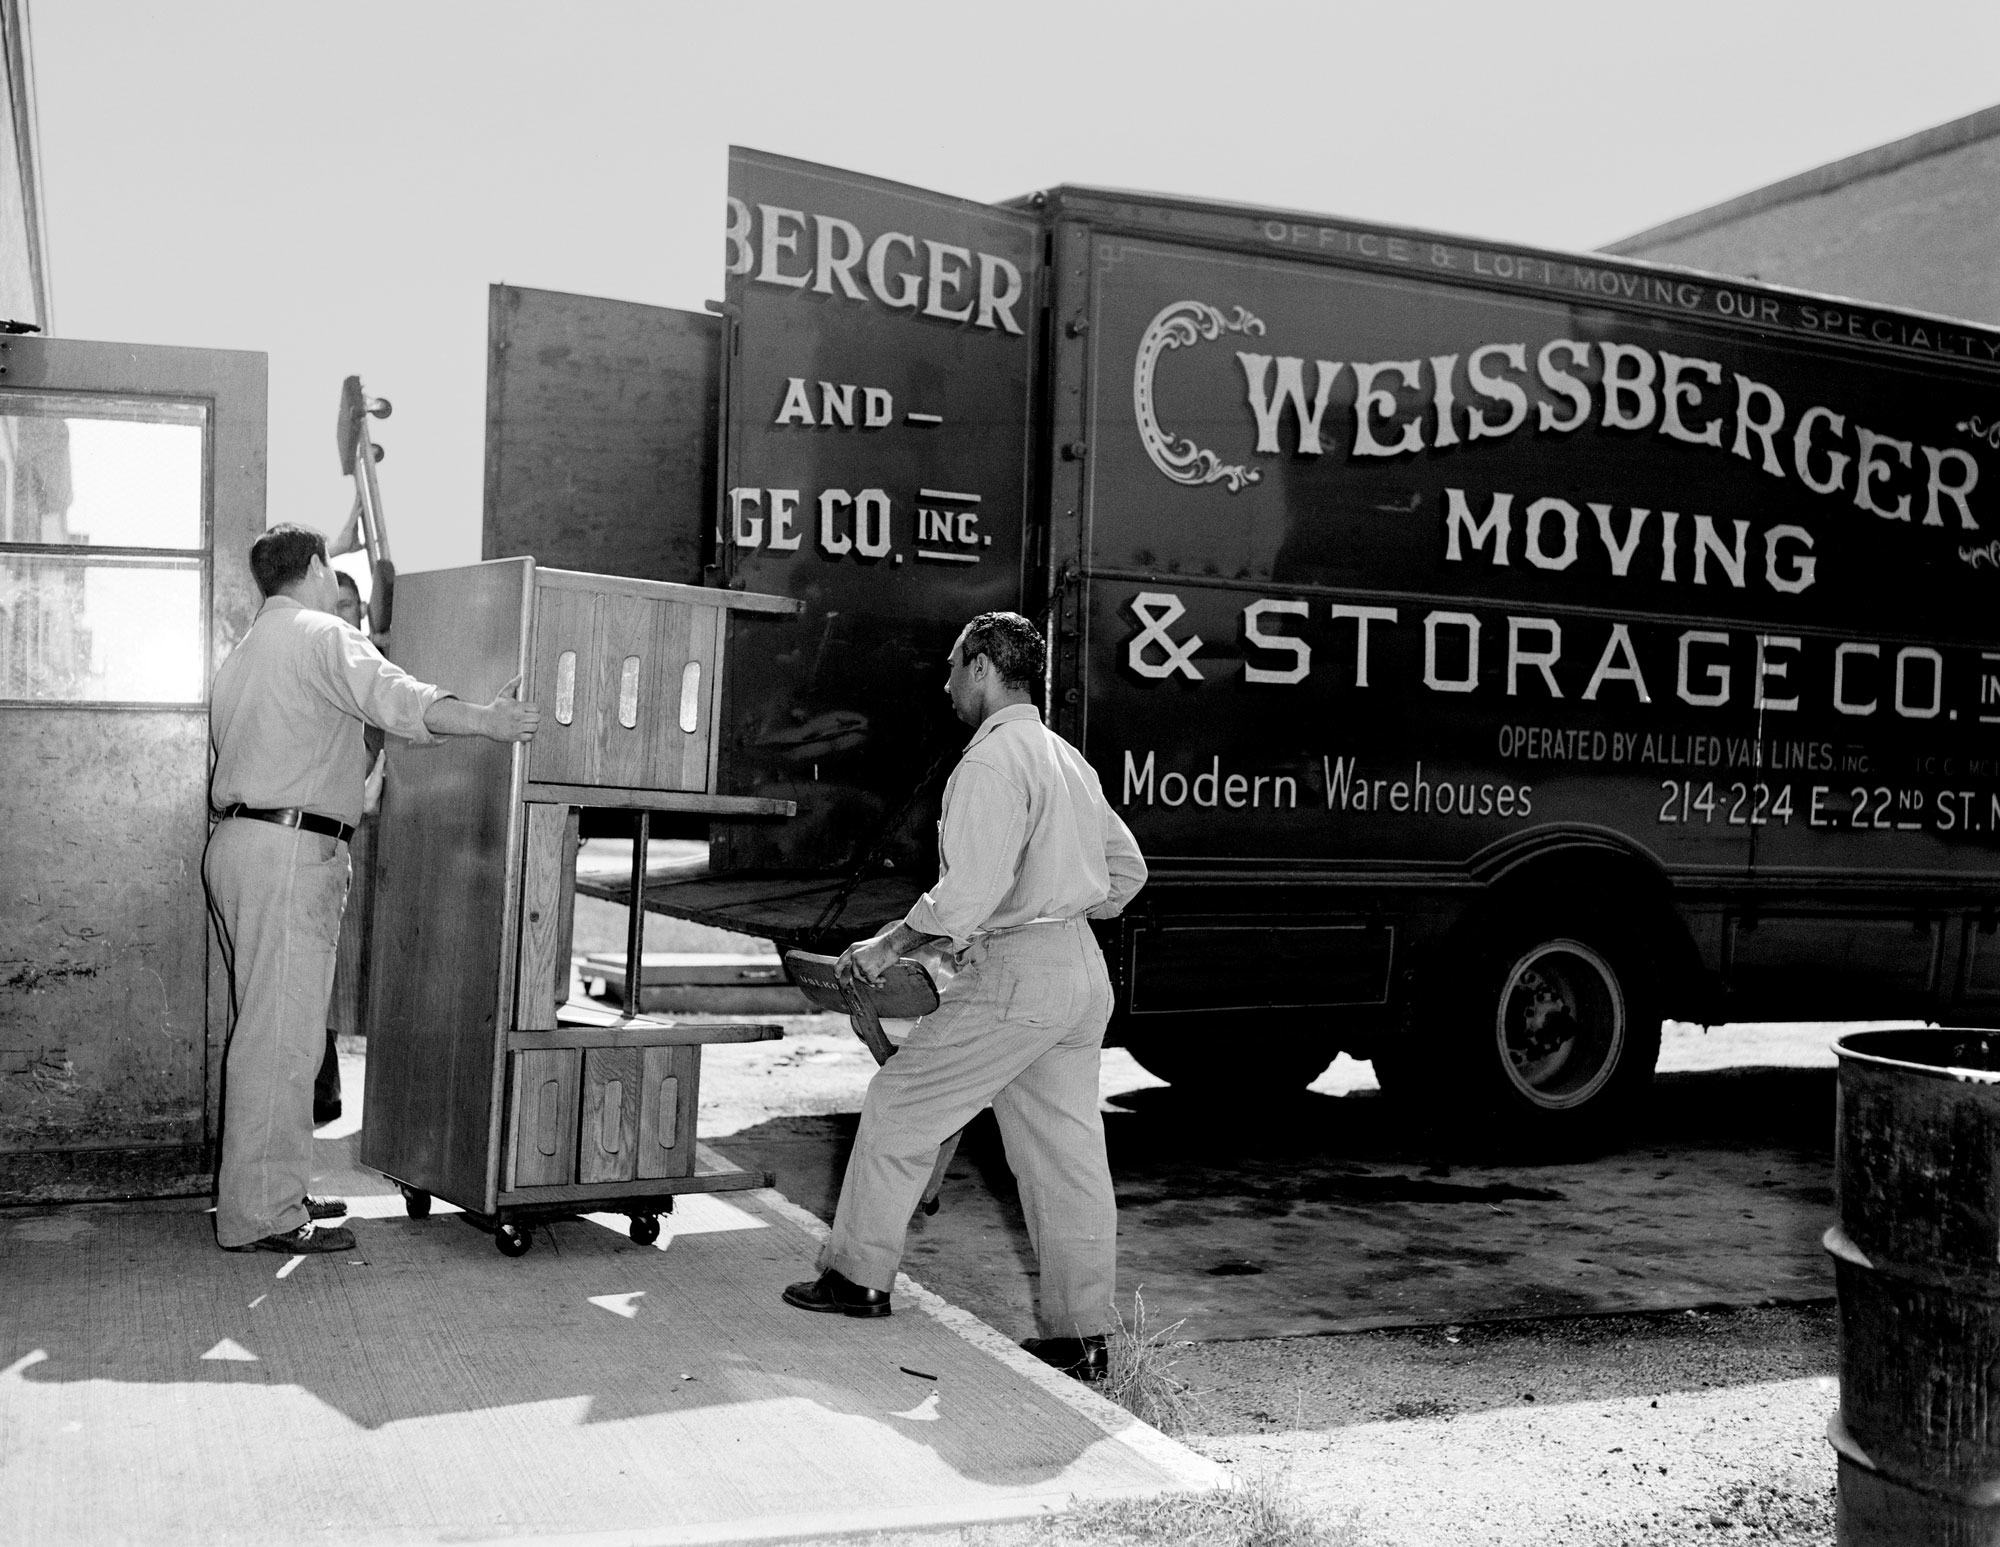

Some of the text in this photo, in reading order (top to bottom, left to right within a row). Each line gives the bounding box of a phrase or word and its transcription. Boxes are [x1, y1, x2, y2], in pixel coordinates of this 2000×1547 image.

[727, 196, 1025, 335] BERGER
[1264, 220, 2000, 360] OFFICE & LOFT MOVING OUR SPECIALTY
[775, 377, 893, 427] AND
[1235, 338, 1980, 530] WEISSBERGER
[716, 487, 992, 563] GE CO. INC.
[1444, 487, 1818, 595] MOVING
[1129, 591, 1205, 680] &
[1244, 598, 1802, 712] STORAGE
[1833, 642, 1958, 720] CO.
[1122, 749, 1532, 817] Modern Warehouses
[1499, 725, 1607, 761] OPERATED
[1612, 732, 1637, 762] BY
[1641, 733, 1721, 767] ALLIED
[1726, 737, 1764, 768] VAN
[1810, 786, 1838, 826] E.
[1937, 790, 1981, 831] ST.
